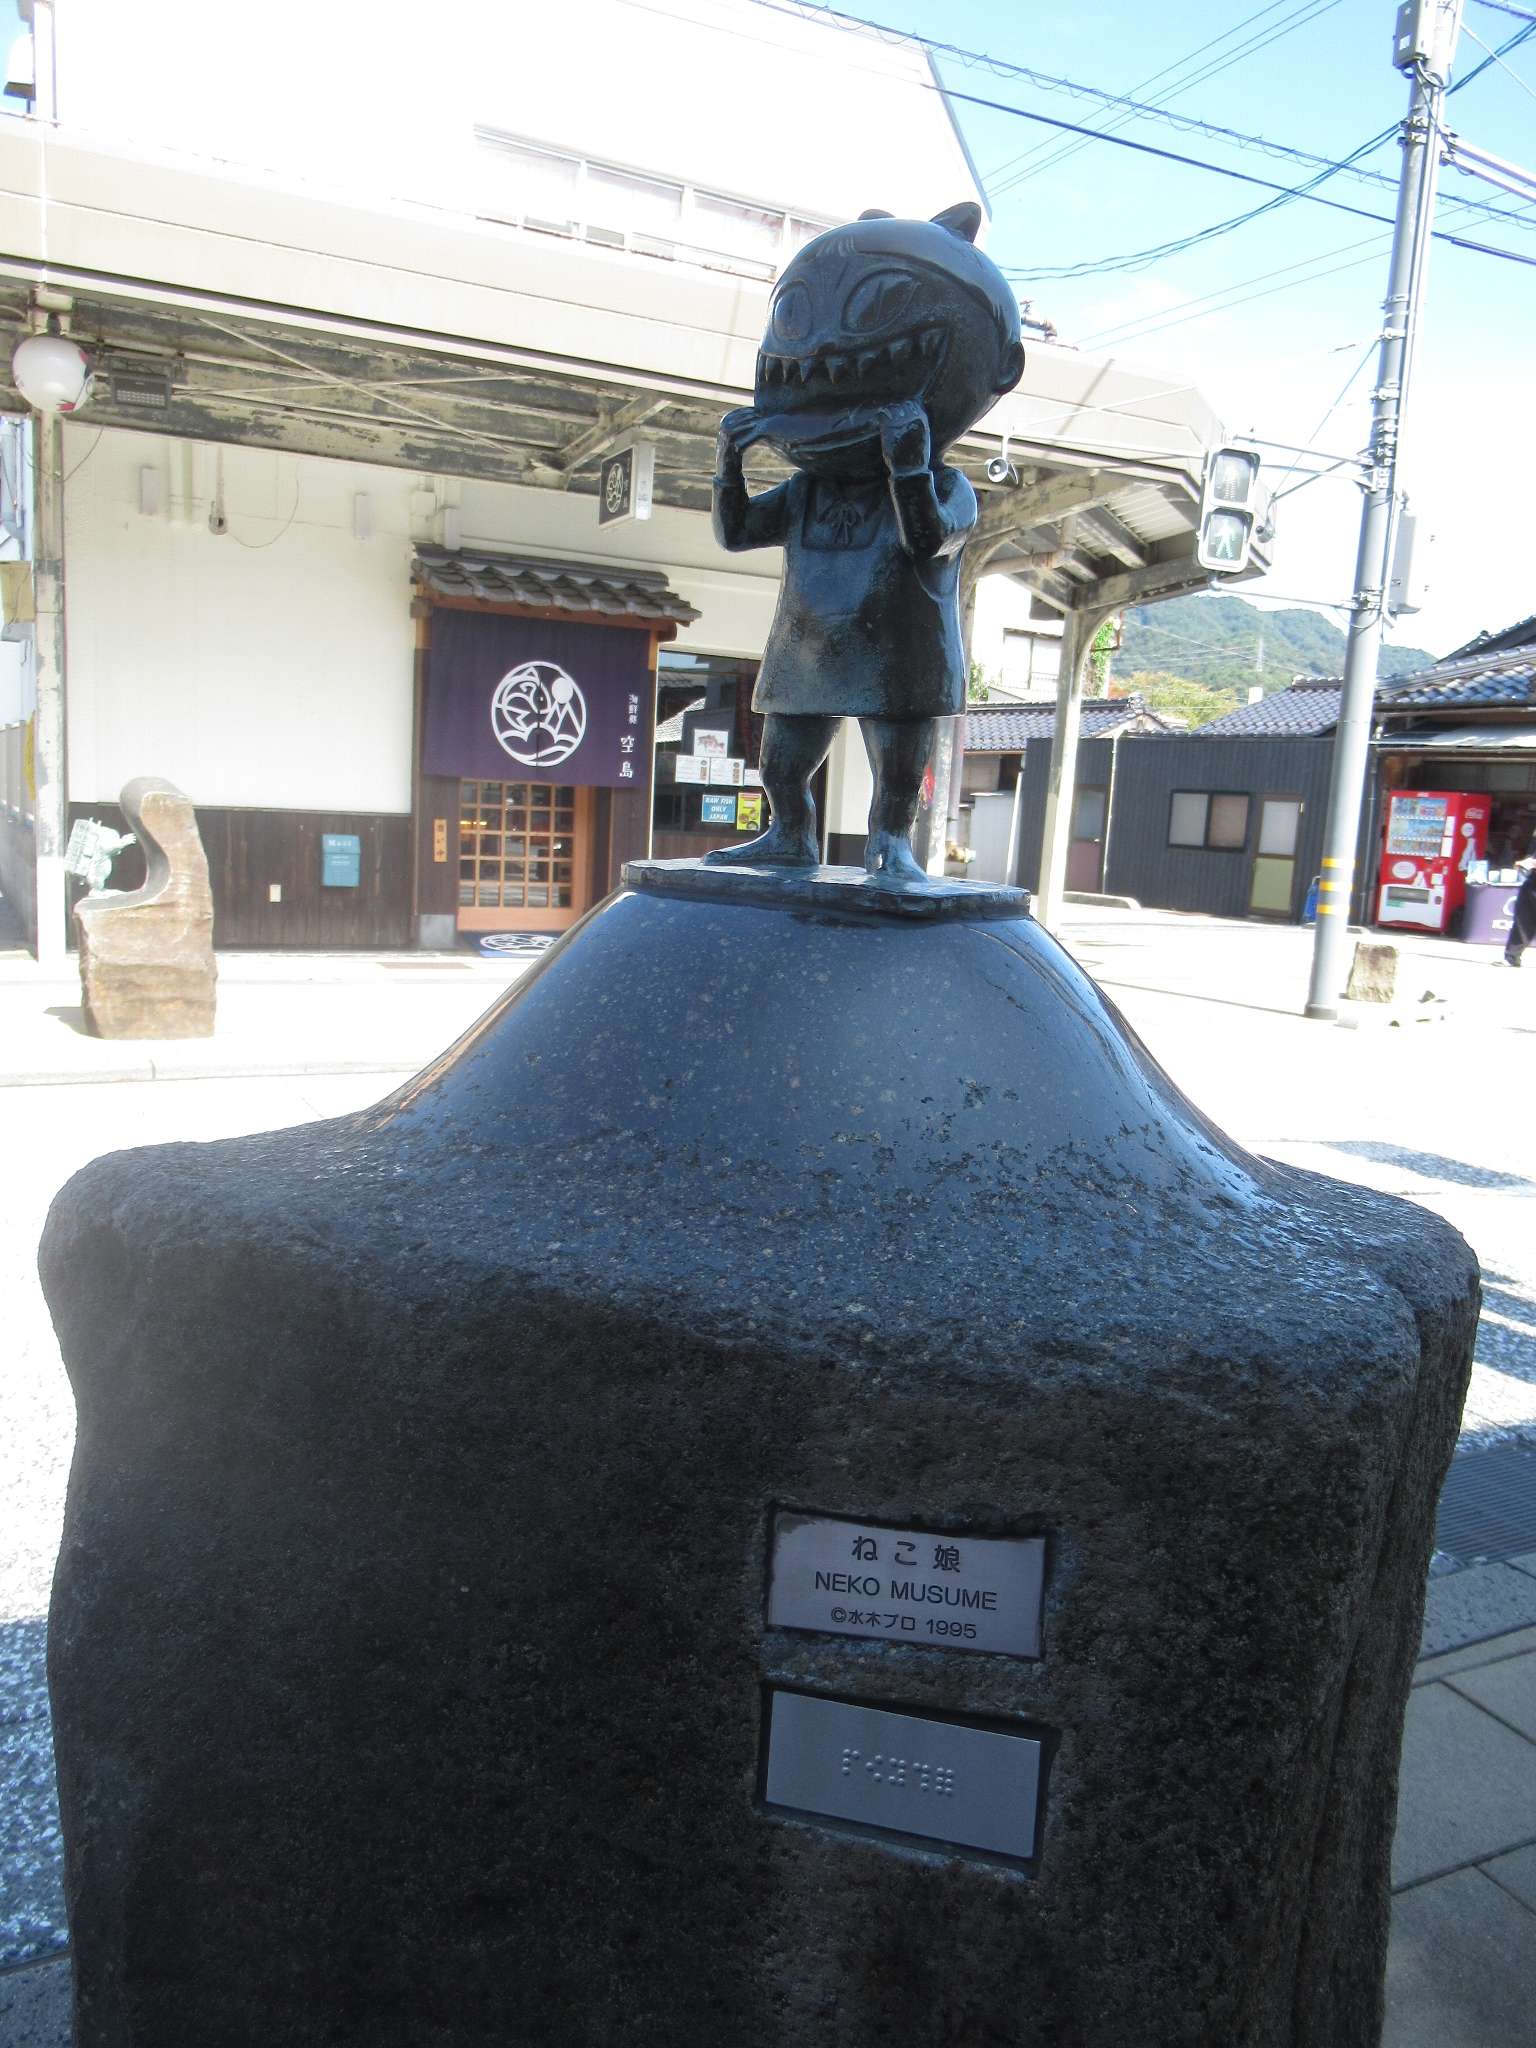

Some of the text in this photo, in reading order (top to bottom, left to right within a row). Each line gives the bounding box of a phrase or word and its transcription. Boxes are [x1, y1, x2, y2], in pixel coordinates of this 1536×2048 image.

[620, 735, 634, 778] 空島
[851, 1535, 961, 1573] ねこ娘
[815, 1571, 998, 1611] NEKO MUSUME
[925, 1618, 977, 1639] 1995
